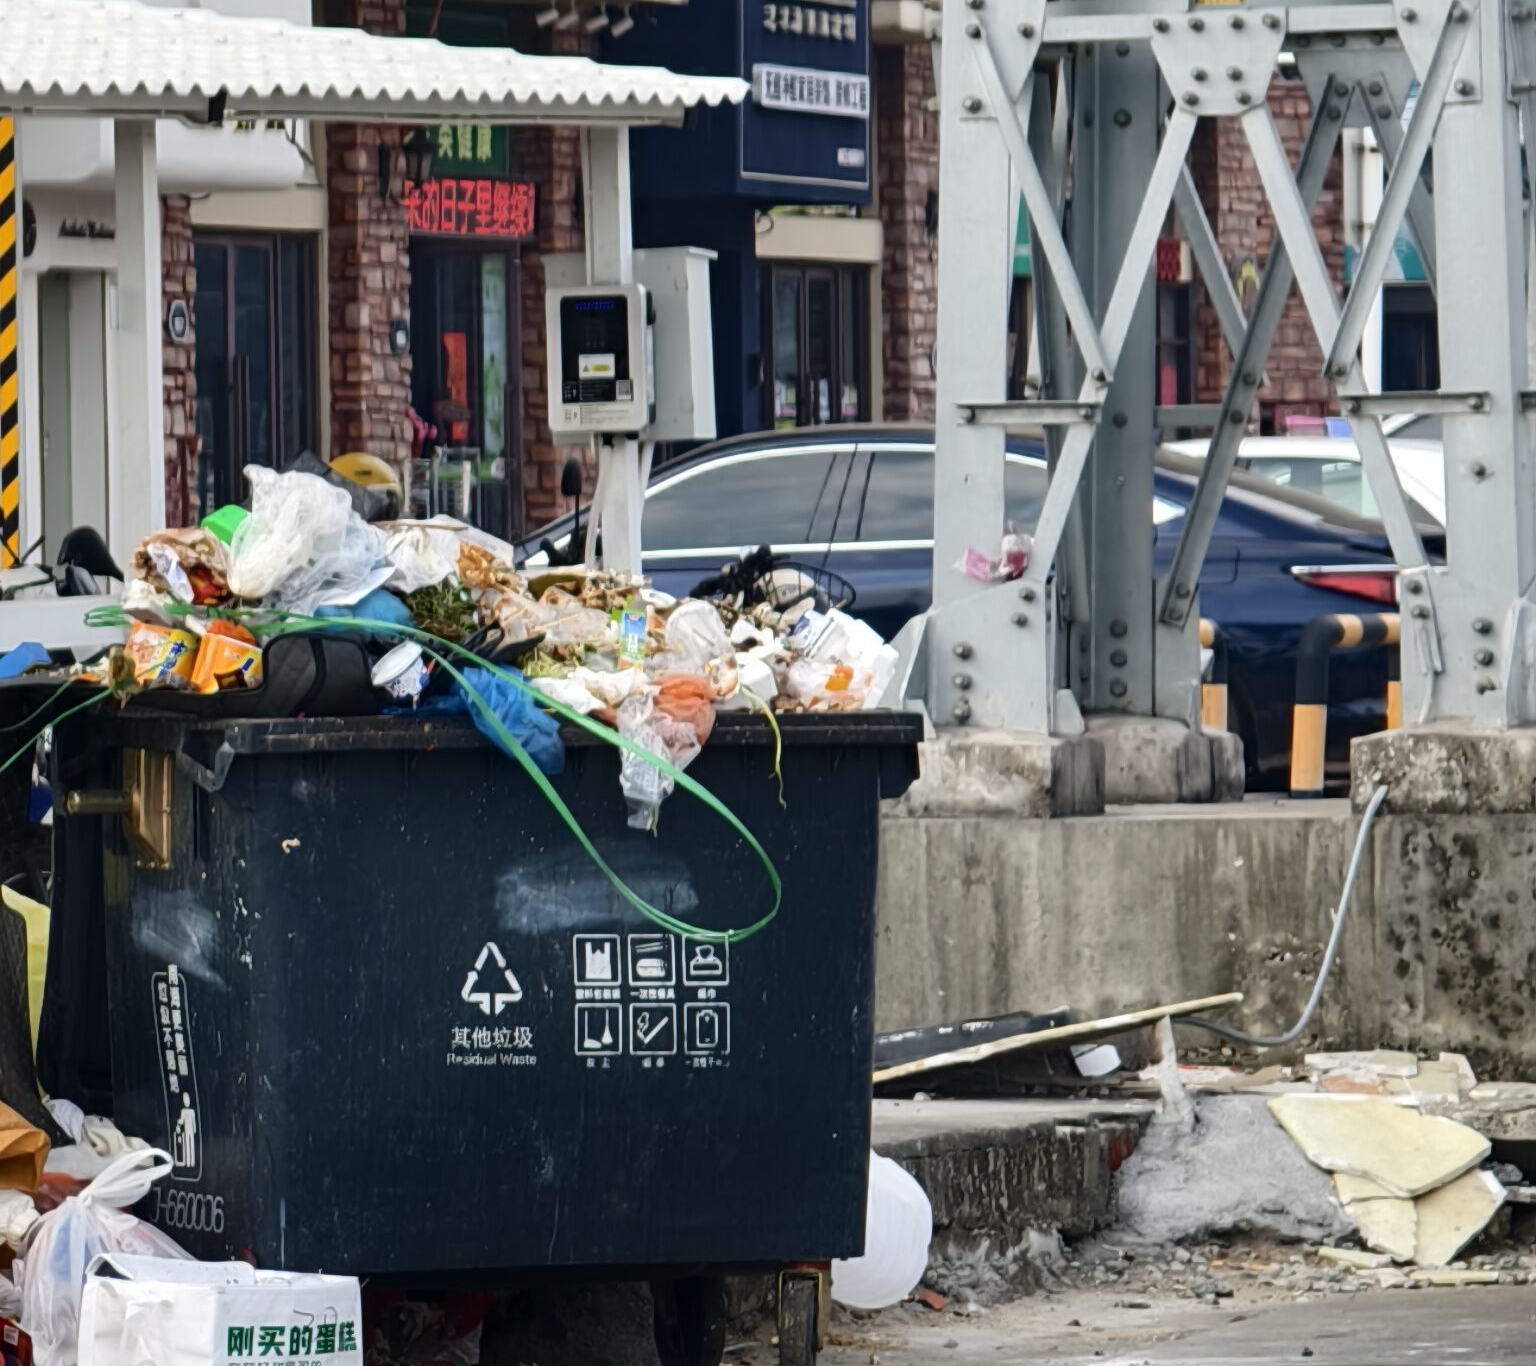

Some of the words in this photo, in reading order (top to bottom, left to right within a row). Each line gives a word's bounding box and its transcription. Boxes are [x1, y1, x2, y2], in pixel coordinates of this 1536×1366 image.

[451, 1026, 533, 1050] 其他垃圾
[446, 1052, 497, 1066] Residual
[499, 1053, 537, 1067] Waste
[227, 1321, 357, 1357] 刚买的蛋糕
